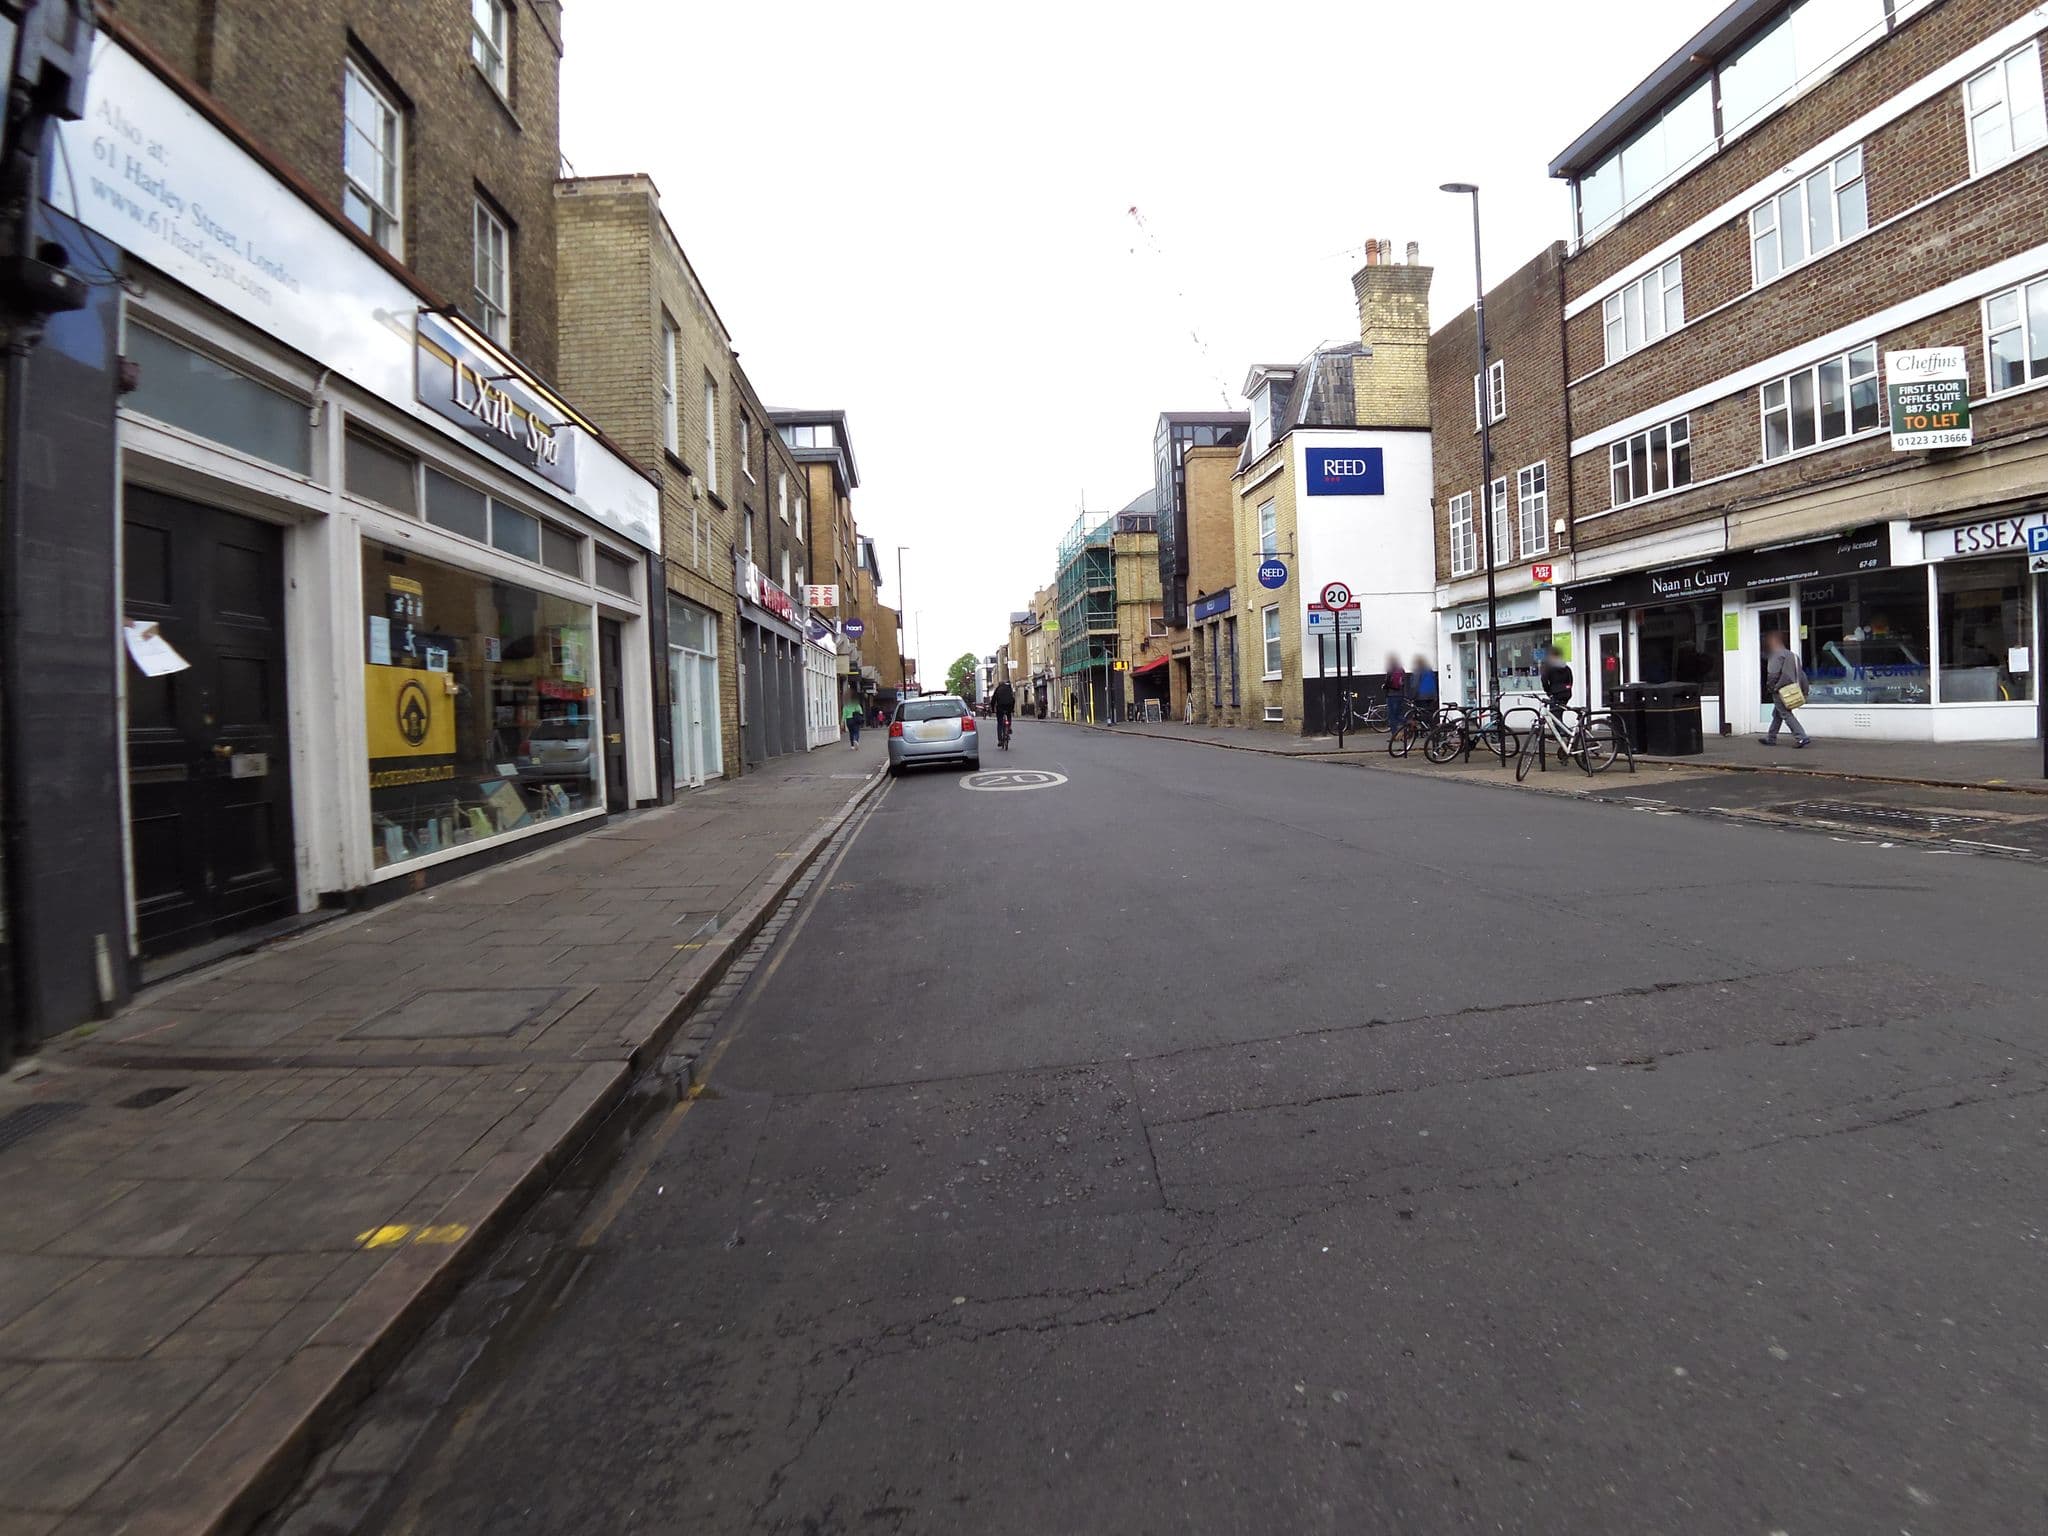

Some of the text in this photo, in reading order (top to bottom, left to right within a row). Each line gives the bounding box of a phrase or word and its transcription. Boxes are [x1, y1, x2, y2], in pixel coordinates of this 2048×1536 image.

[97, 98, 142, 144] Also
[93, 137, 116, 168] 61
[125, 155, 184, 219] Harley
[1896, 353, 1958, 371] Cheffins
[1899, 382, 1959, 395] FIRST FLOOR
[1899, 392, 1961, 404] OFFICE SUITE
[1906, 402, 1953, 414] 887 SQ FT
[1903, 413, 1960, 430] TO LET
[526, 411, 559, 467] Spa
[1898, 433, 1967, 446] 01223 213666
[1324, 459, 1367, 476] REED
[1954, 518, 2026, 553] ESSEX
[2033, 527, 2048, 551] P
[1261, 567, 1285, 578] REED
[1535, 566, 1550, 574] JUST
[1652, 569, 1730, 594] Naan n Curry
[1327, 590, 1347, 603] 20
[846, 622, 863, 632] haart
[1456, 612, 1482, 630] Dars
[1833, 686, 1863, 696] DARS
[975, 773, 1049, 786] 20
